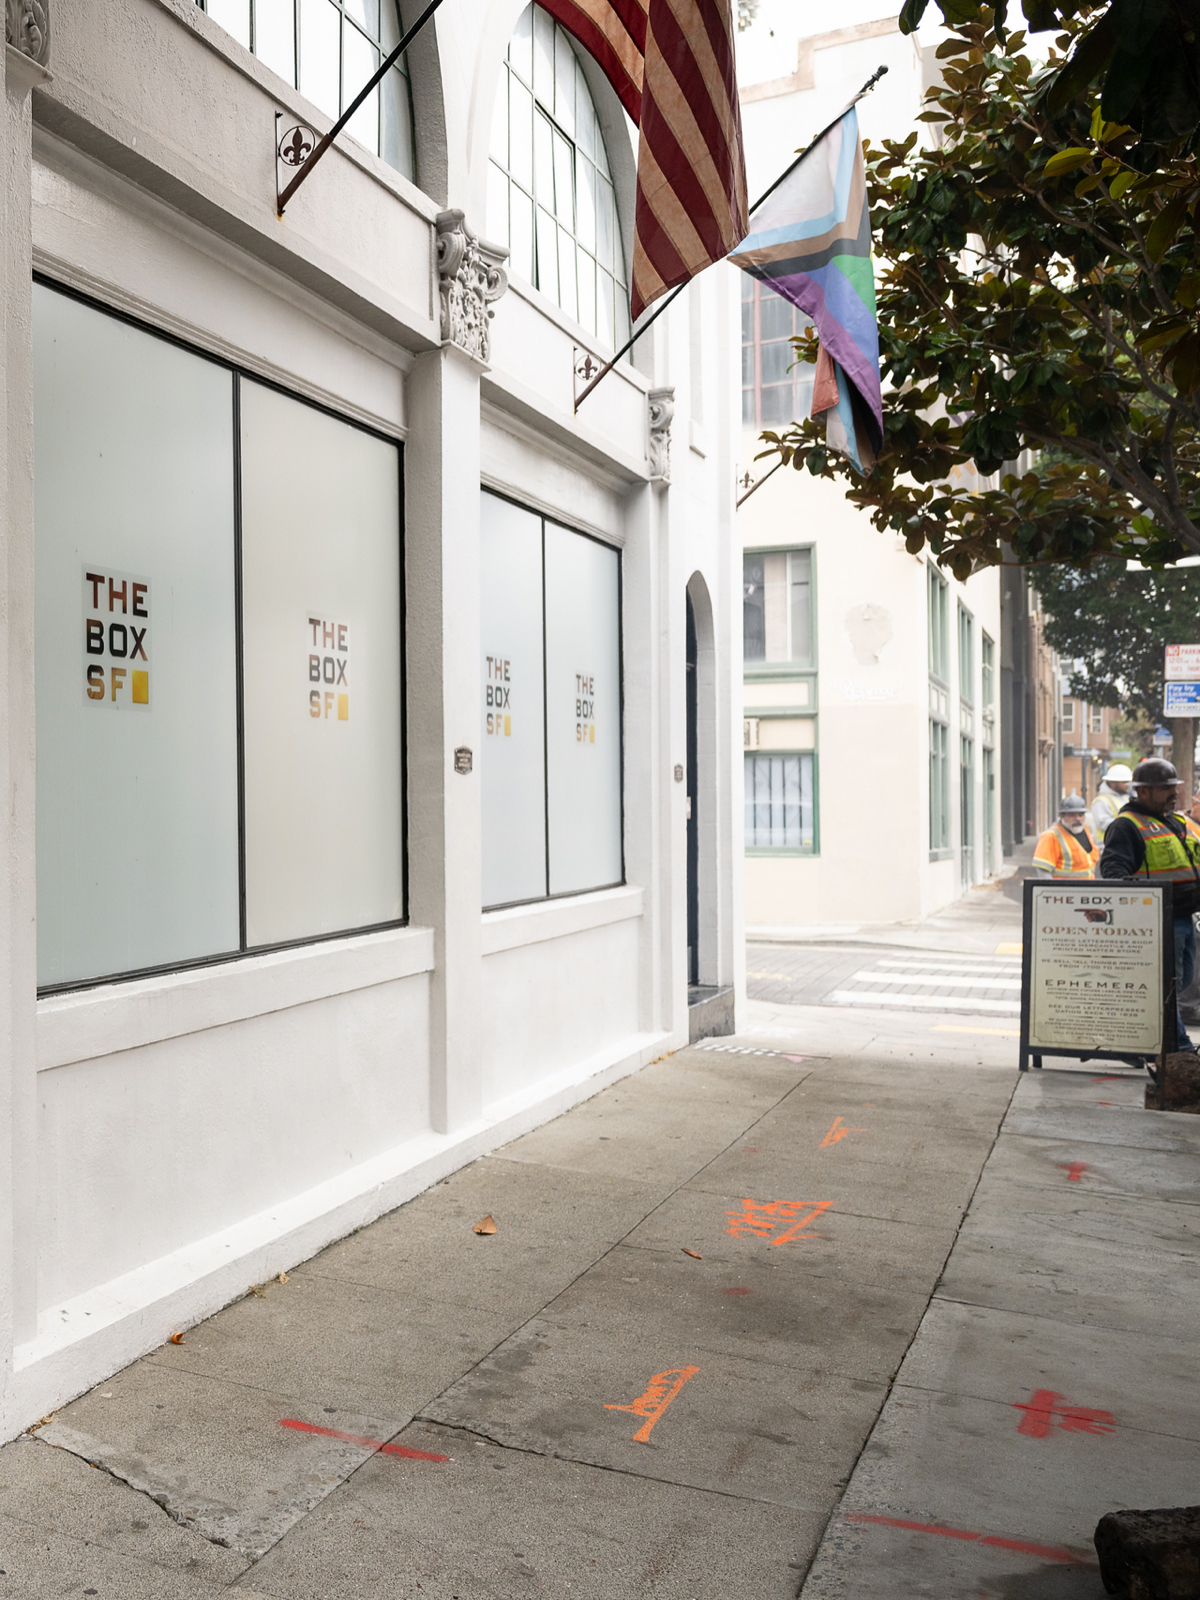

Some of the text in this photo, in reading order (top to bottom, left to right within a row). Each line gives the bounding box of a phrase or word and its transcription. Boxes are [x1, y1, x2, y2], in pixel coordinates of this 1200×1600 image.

[86, 572, 148, 618] THE
[86, 618, 148, 662] BOX
[308, 618, 349, 652] THE
[308, 654, 349, 687] BOX
[486, 656, 511, 682] THE
[86, 664, 127, 702] SF
[576, 674, 594, 696] THE
[309, 690, 335, 720] SF
[486, 684, 511, 710] BOX
[576, 698, 595, 720] BOX
[486, 712, 502, 736] SF
[576, 722, 588, 743] SF
[1042, 896, 1140, 905] THE BOX SF
[1042, 926, 1153, 936] OPEN TODAY!
[1045, 978, 1148, 990] EPHEMERA
